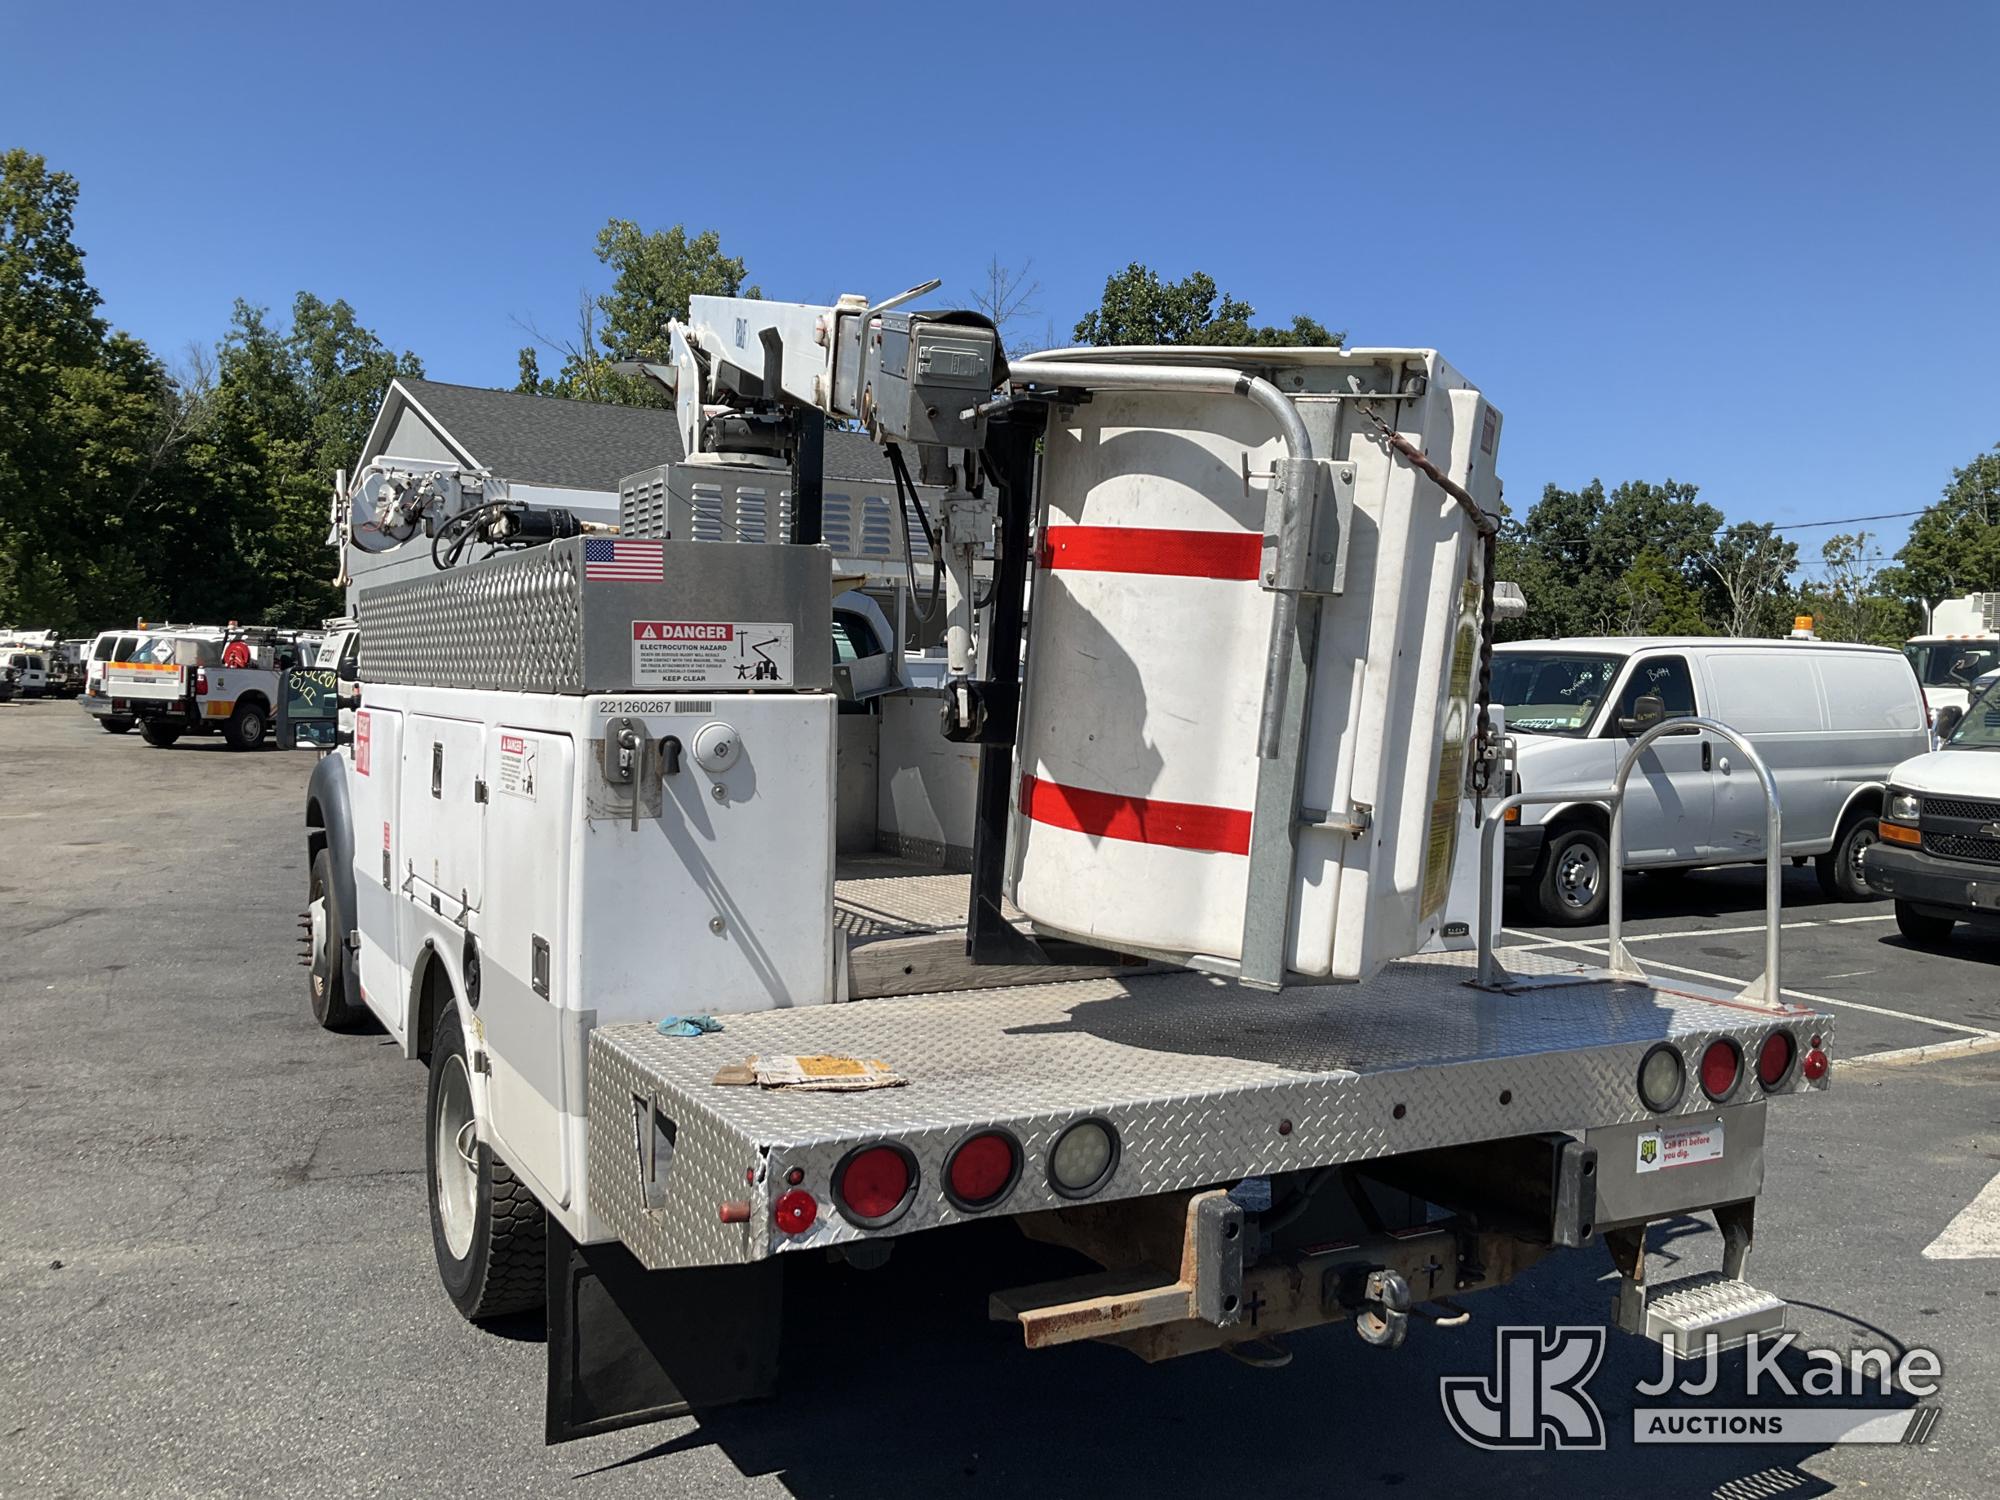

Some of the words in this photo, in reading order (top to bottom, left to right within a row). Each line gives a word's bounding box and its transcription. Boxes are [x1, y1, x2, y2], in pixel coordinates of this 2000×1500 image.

[662, 625, 727, 639] DANGER
[600, 701, 672, 713] 221260267
[1642, 1140, 1656, 1156] 811
[1664, 1141, 1676, 1149] Call
[1678, 1139, 1688, 1147] 811
[1689, 1137, 1710, 1146] before
[1664, 1152, 1675, 1161] you
[1677, 1150, 1690, 1159] dig.
